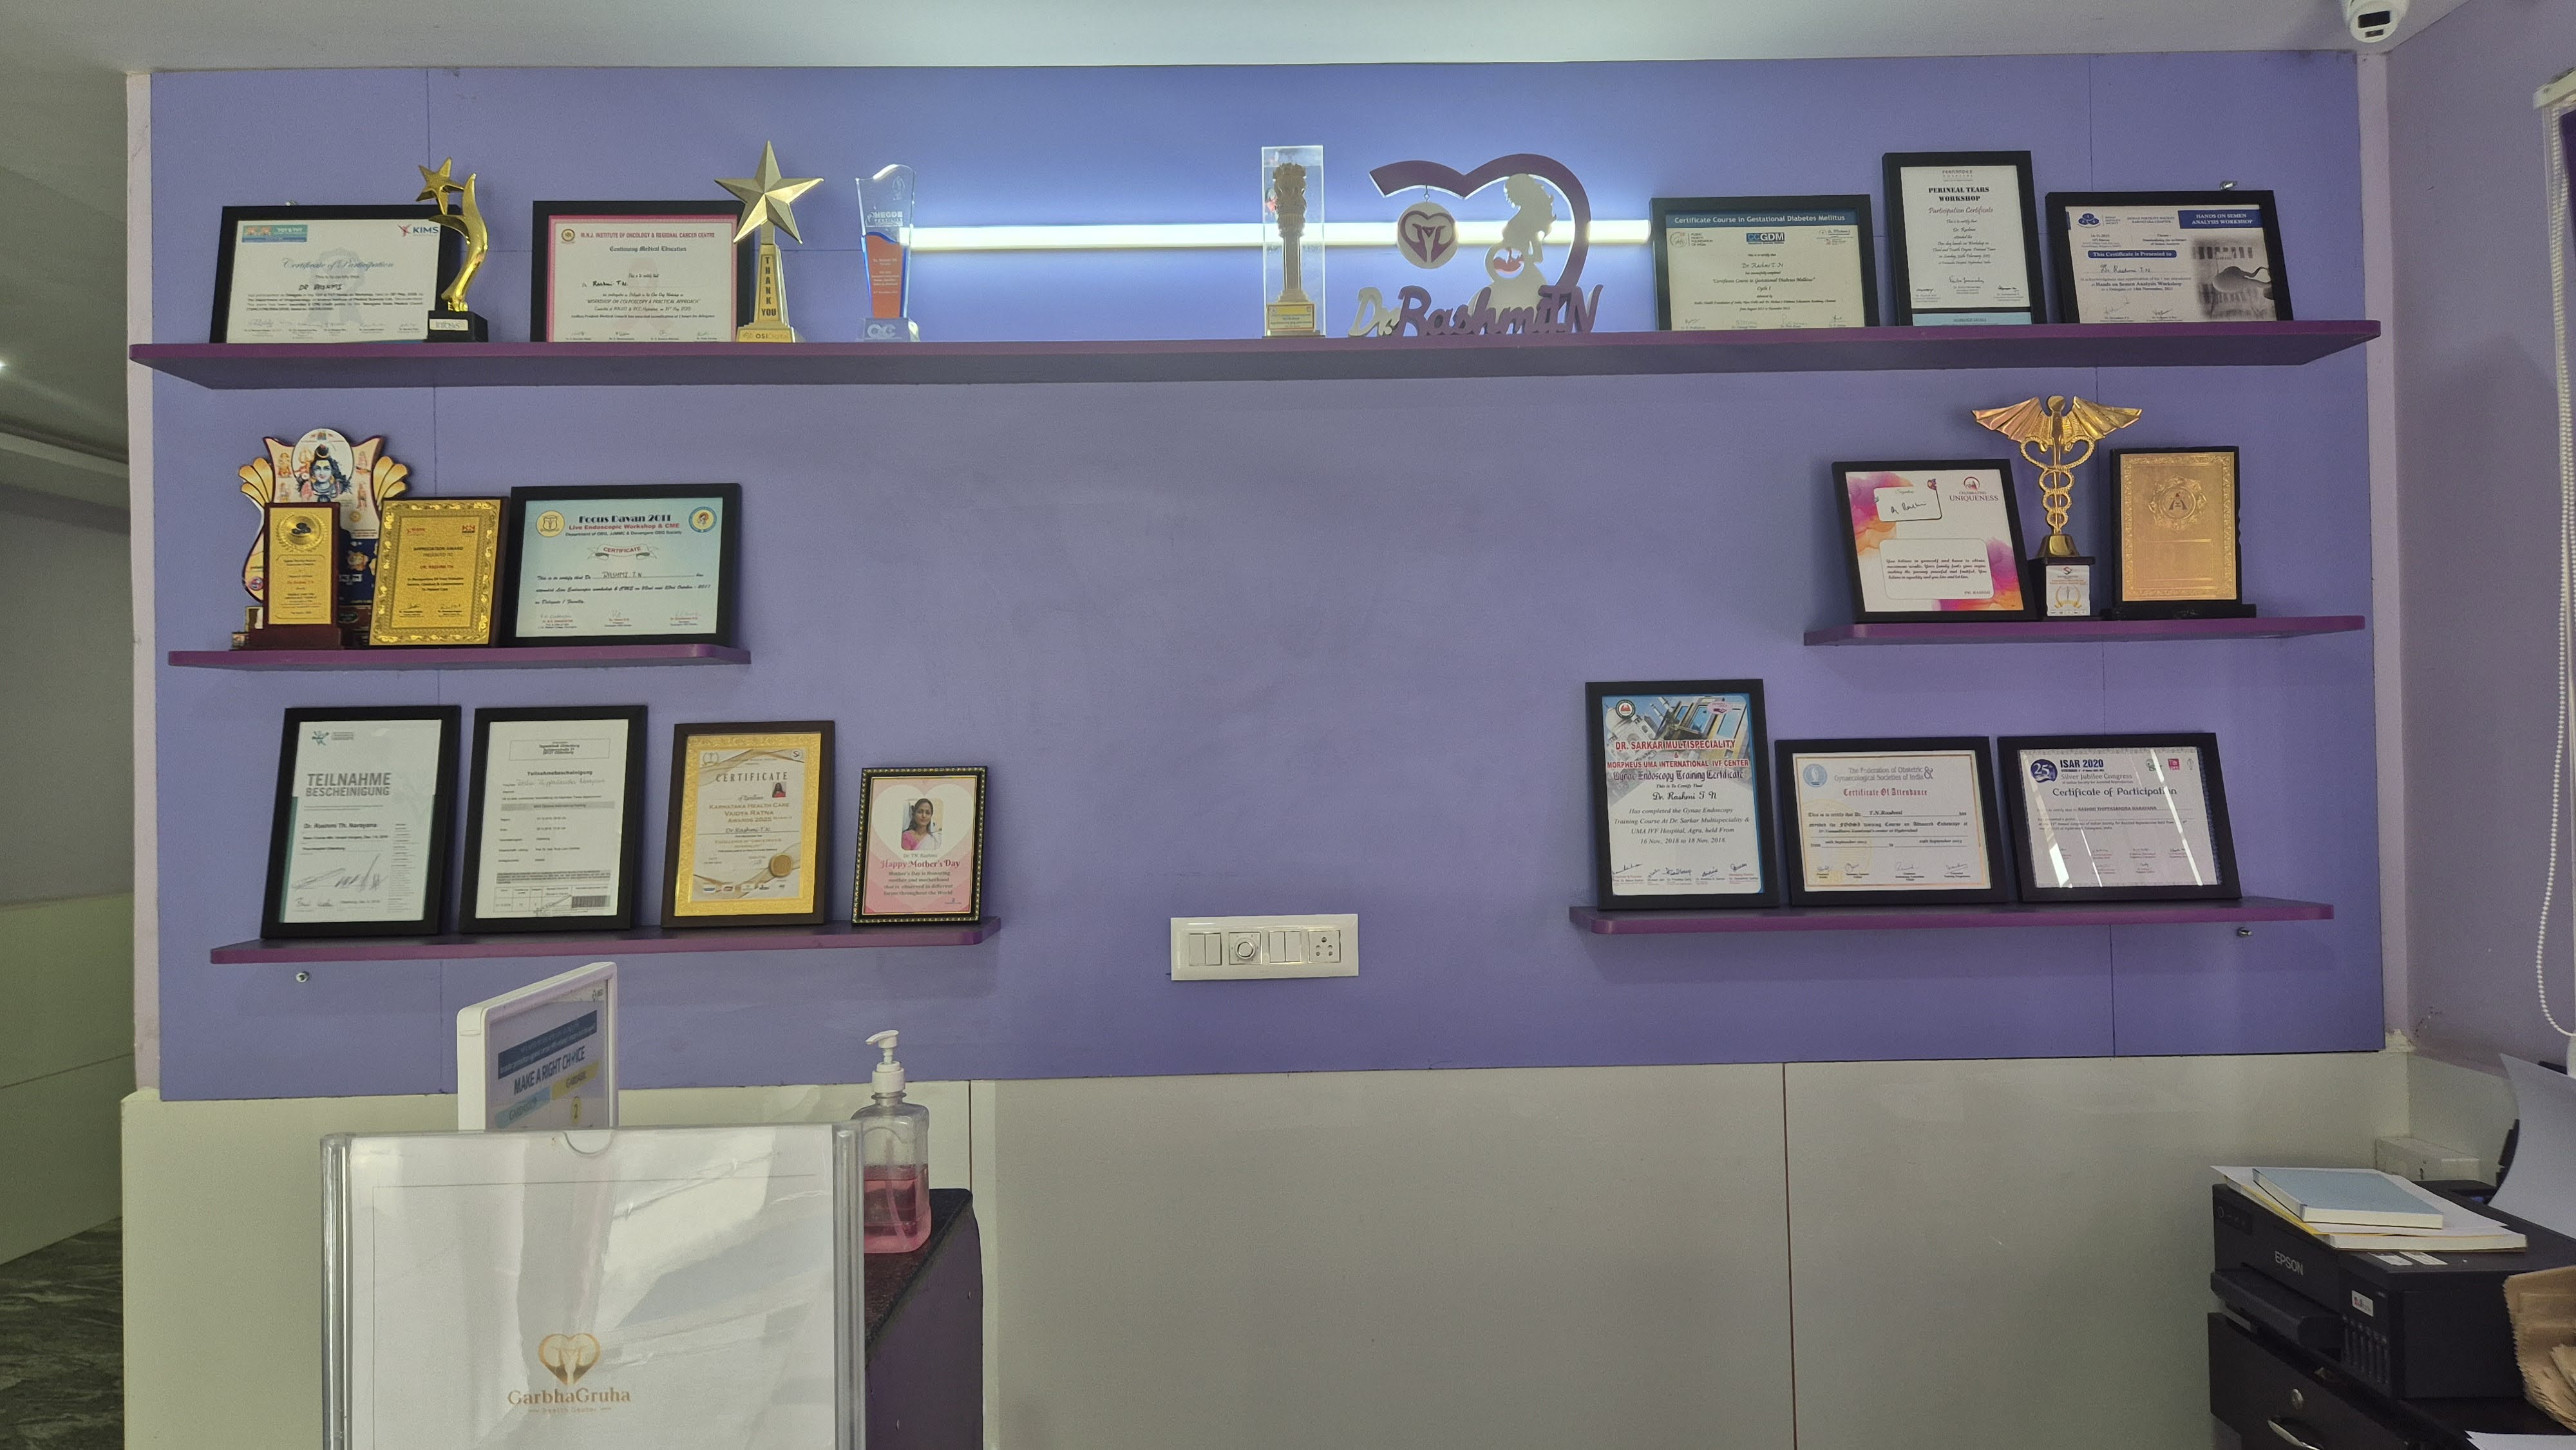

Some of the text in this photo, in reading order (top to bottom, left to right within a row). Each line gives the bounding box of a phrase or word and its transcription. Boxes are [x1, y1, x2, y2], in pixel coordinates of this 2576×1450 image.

[1929, 206, 1993, 216] Participation Certificate
[1747, 233, 1785, 241] CCGDM
[283, 258, 393, 270] Certificate of Participation
[1394, 286, 1552, 335] Rashmi
[1631, 741, 1663, 749] SARKAR
[1665, 740, 1735, 749] MULTISPECIALITY
[2083, 759, 2104, 767] 2020
[716, 772, 788, 782] CERTIFICATE
[1638, 771, 1674, 782] Endoscopy
[1676, 770, 1705, 781] Training
[1707, 770, 1743, 779] Certificate
[1924, 766, 1933, 779] &
[307, 773, 392, 786] TEILNAHME
[306, 787, 390, 796] BESCHEINIGUNG
[2052, 788, 2101, 797] Certificate
[2104, 788, 2113, 796] of
[881, 860, 907, 869] Happy
[943, 860, 960, 868] Day
[515, 1071, 535, 1095] MAKE
[536, 1070, 541, 1084] A
[542, 1057, 562, 1080] RIGHT
[2275, 1250, 2304, 1276] EPSON
[507, 1388, 631, 1405] GarbhaGruha
